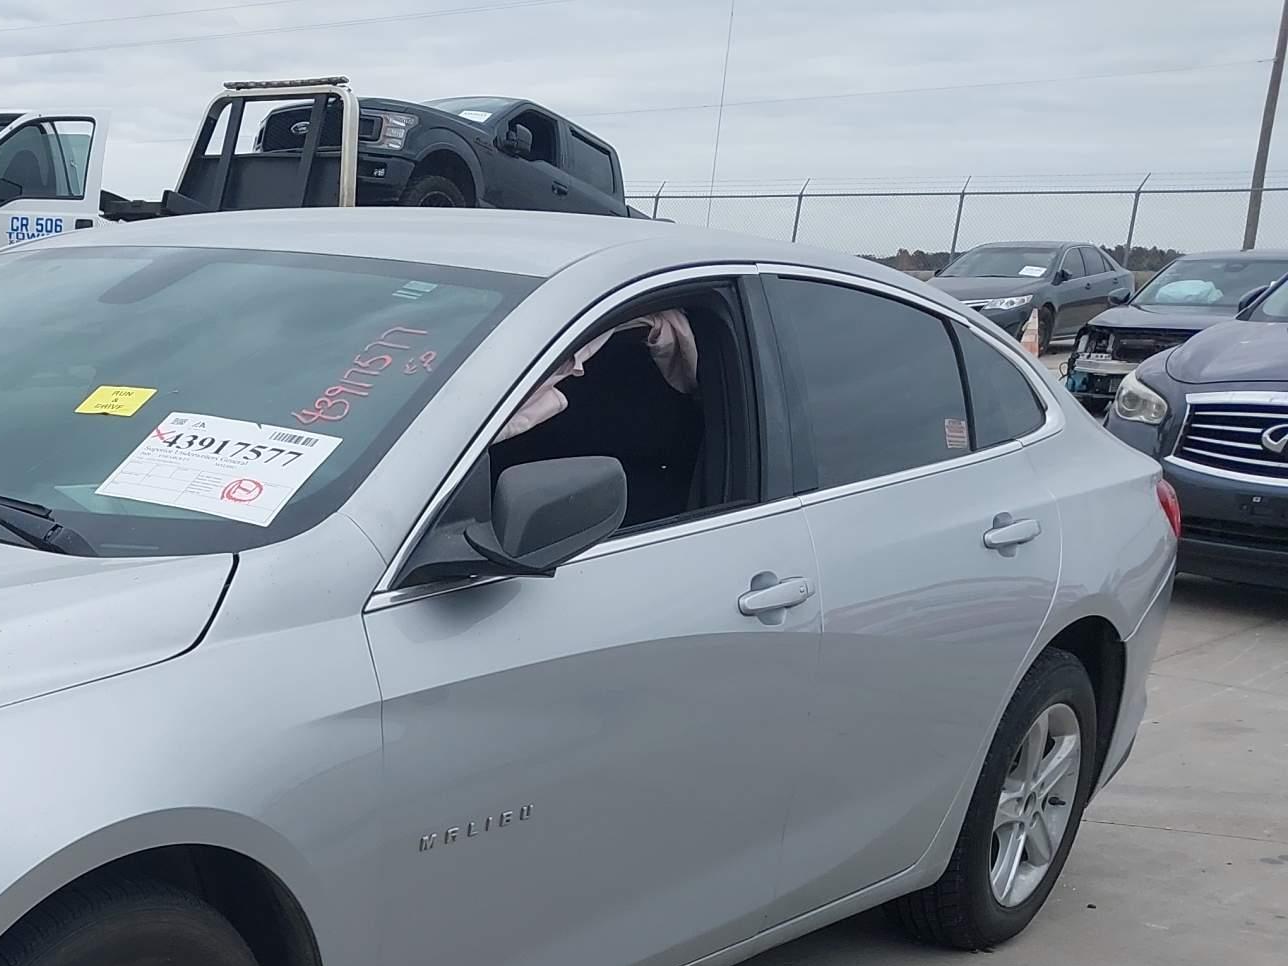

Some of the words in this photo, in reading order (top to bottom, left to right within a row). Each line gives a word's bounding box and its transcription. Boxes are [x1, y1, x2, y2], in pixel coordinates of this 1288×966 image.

[11, 217, 29, 232] CR
[35, 218, 63, 233] 506
[291, 326, 428, 425] 43917577
[162, 432, 304, 468] 43917577
[418, 803, 534, 852] MALIBU
